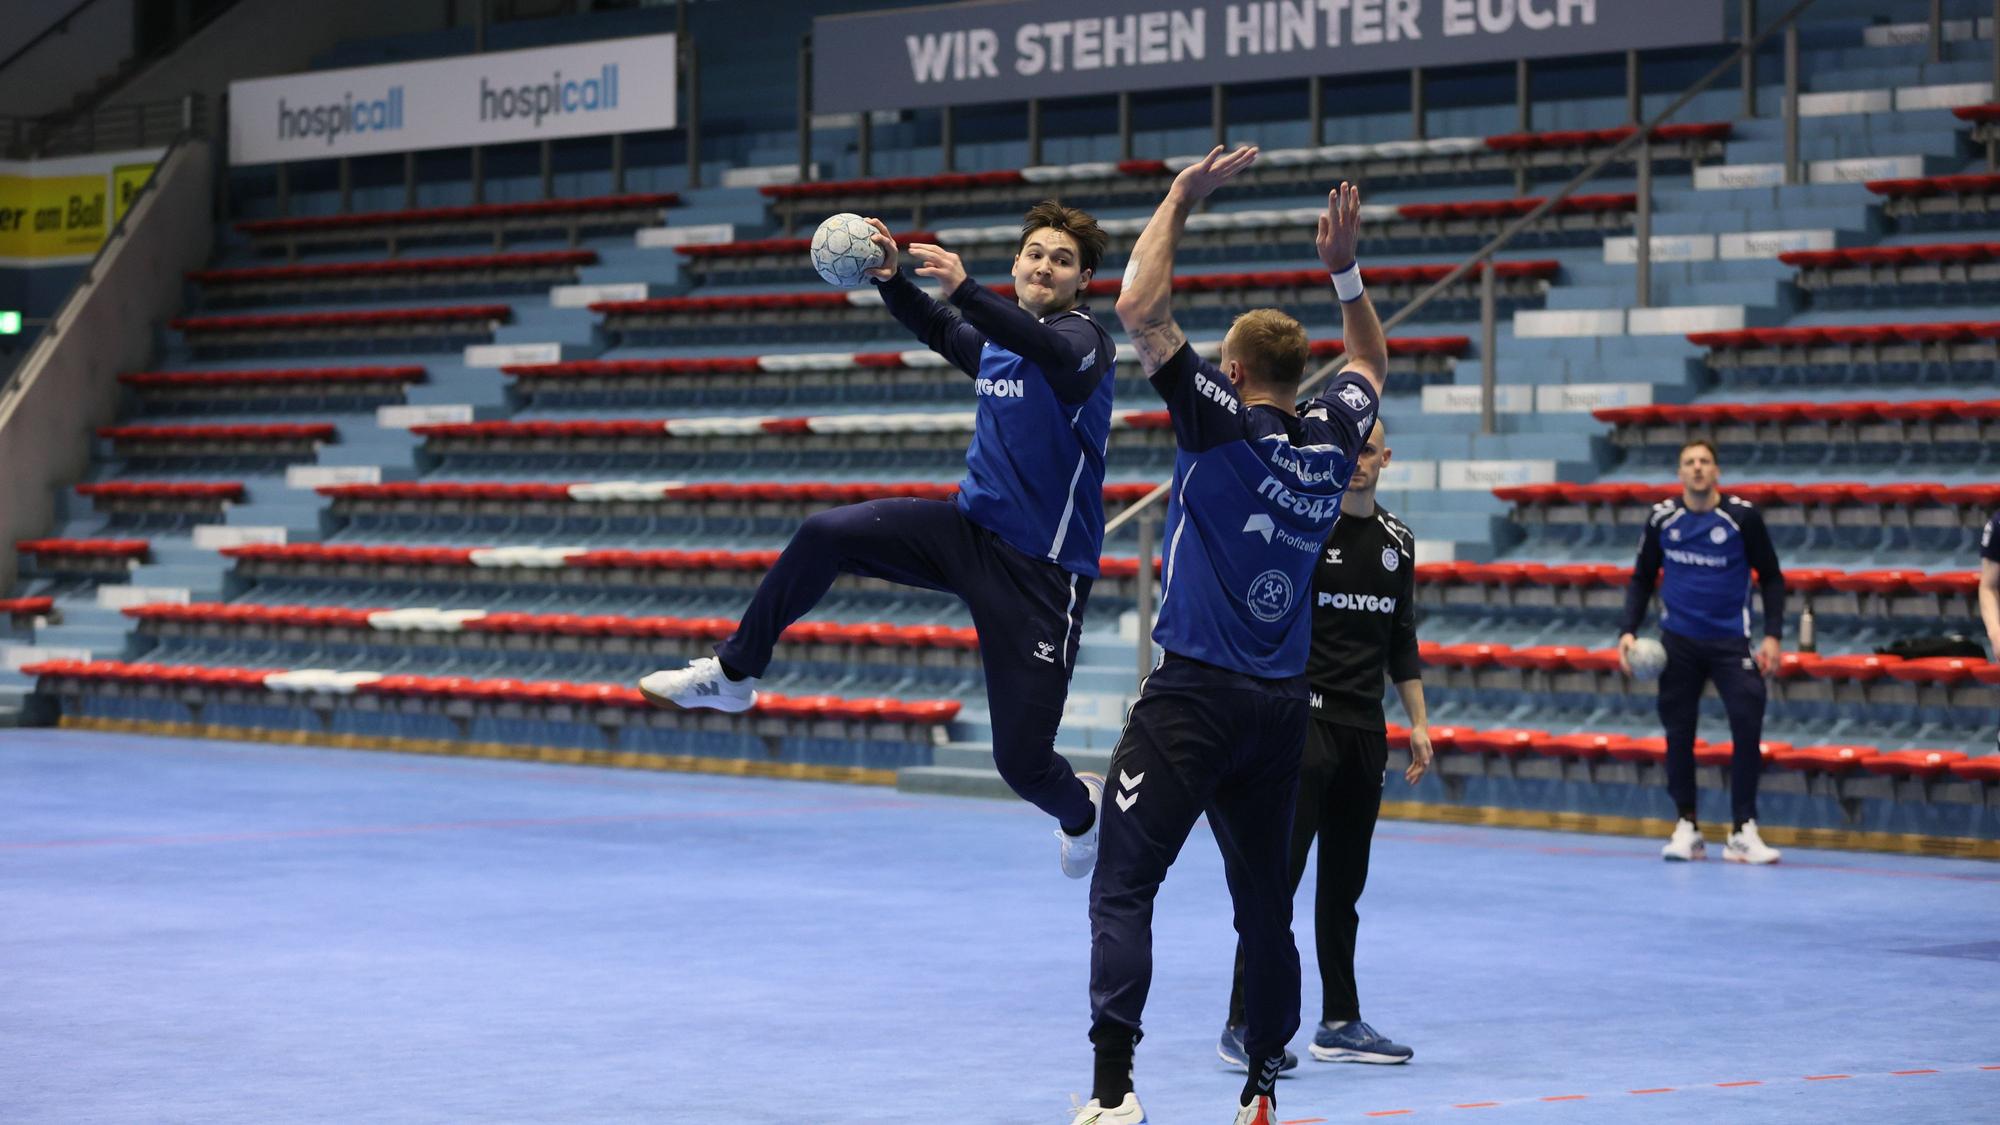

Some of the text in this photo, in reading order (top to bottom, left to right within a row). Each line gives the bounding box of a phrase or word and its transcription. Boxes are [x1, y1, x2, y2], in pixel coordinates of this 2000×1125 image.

[906, 0, 1596, 83] WIR STEHEN HINTER EUCH
[277, 85, 405, 146] hospicall
[478, 63, 620, 127] hospicall
[1194, 371, 1238, 415] REWE
[1256, 475, 1338, 524] neo42
